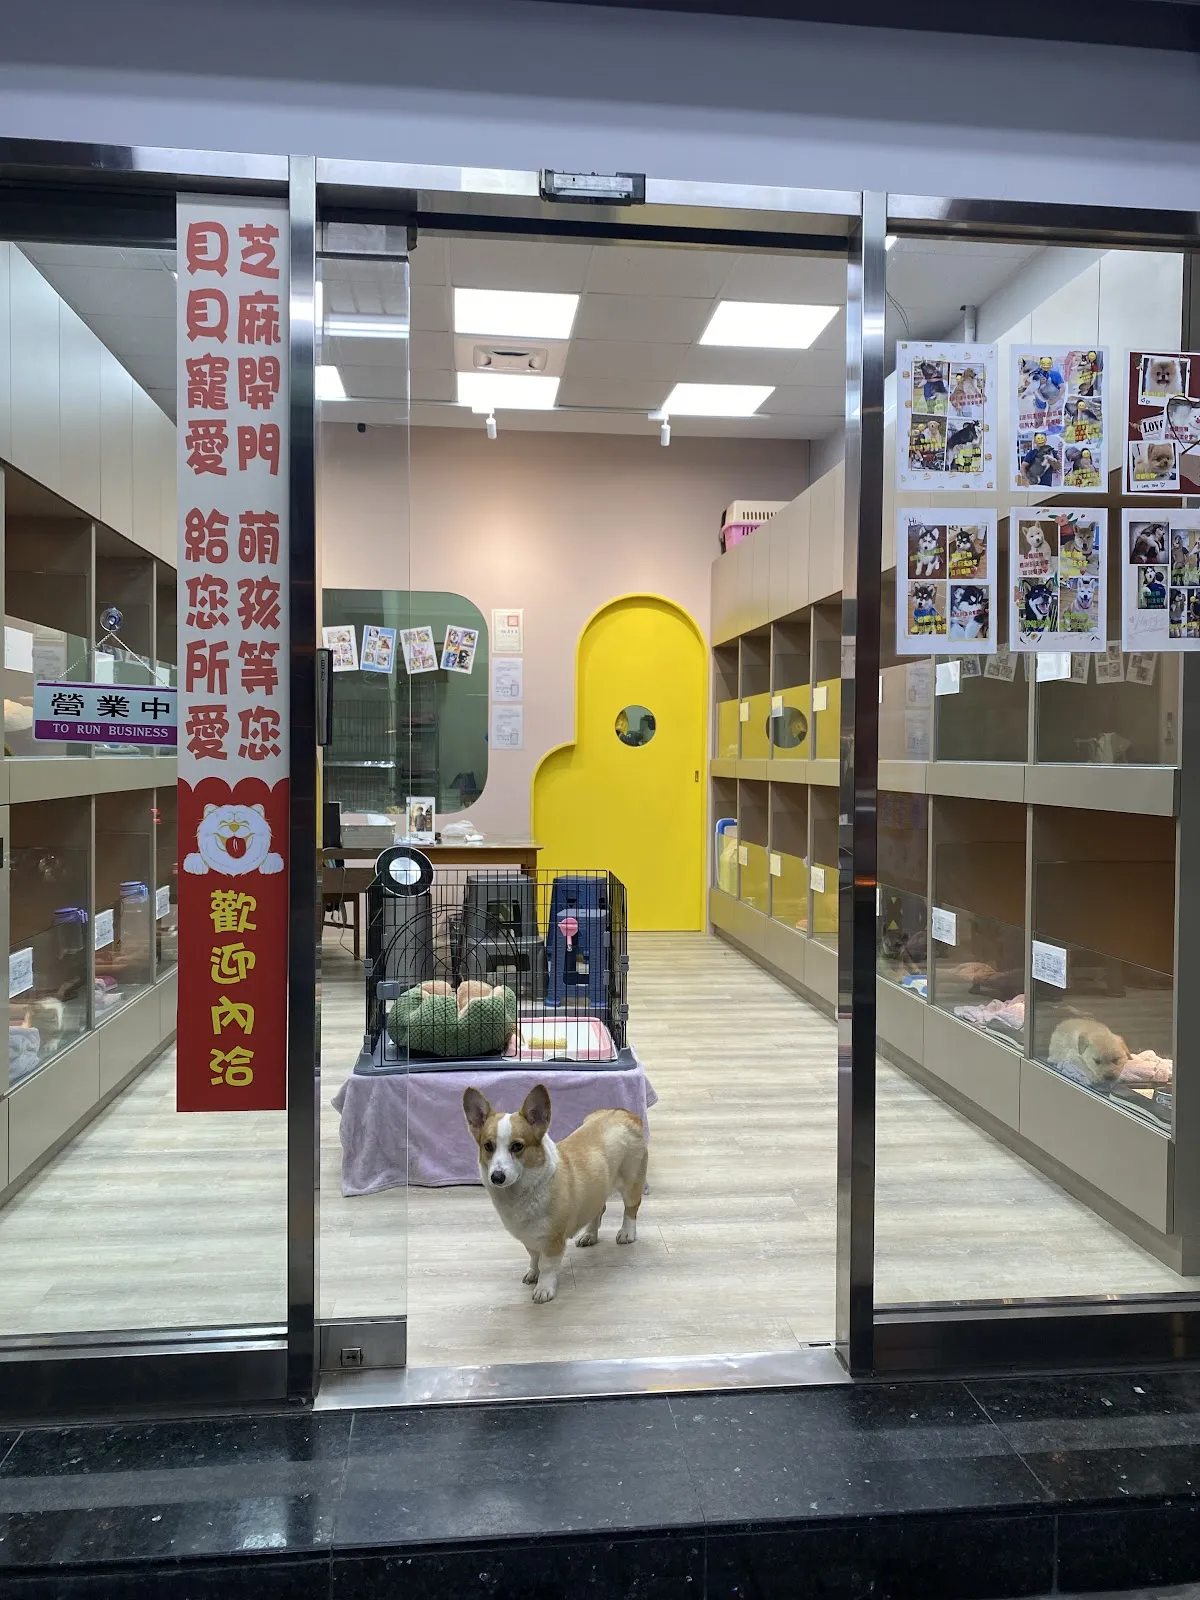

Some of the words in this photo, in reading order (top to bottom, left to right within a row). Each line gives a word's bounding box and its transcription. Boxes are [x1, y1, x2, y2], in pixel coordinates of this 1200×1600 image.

[185, 221, 229, 477] 貝貝寵愛
[237, 222, 281, 476] 芝麻開門
[51, 692, 170, 720] 營業中
[52, 723, 69, 734] TO
[77, 725, 101, 735] RUN
[108, 726, 169, 738] BUSINESS
[185, 507, 230, 761] 給您所愛
[237, 510, 282, 761] 萌孩等您
[209, 889, 257, 1087] 歡迎內洽
